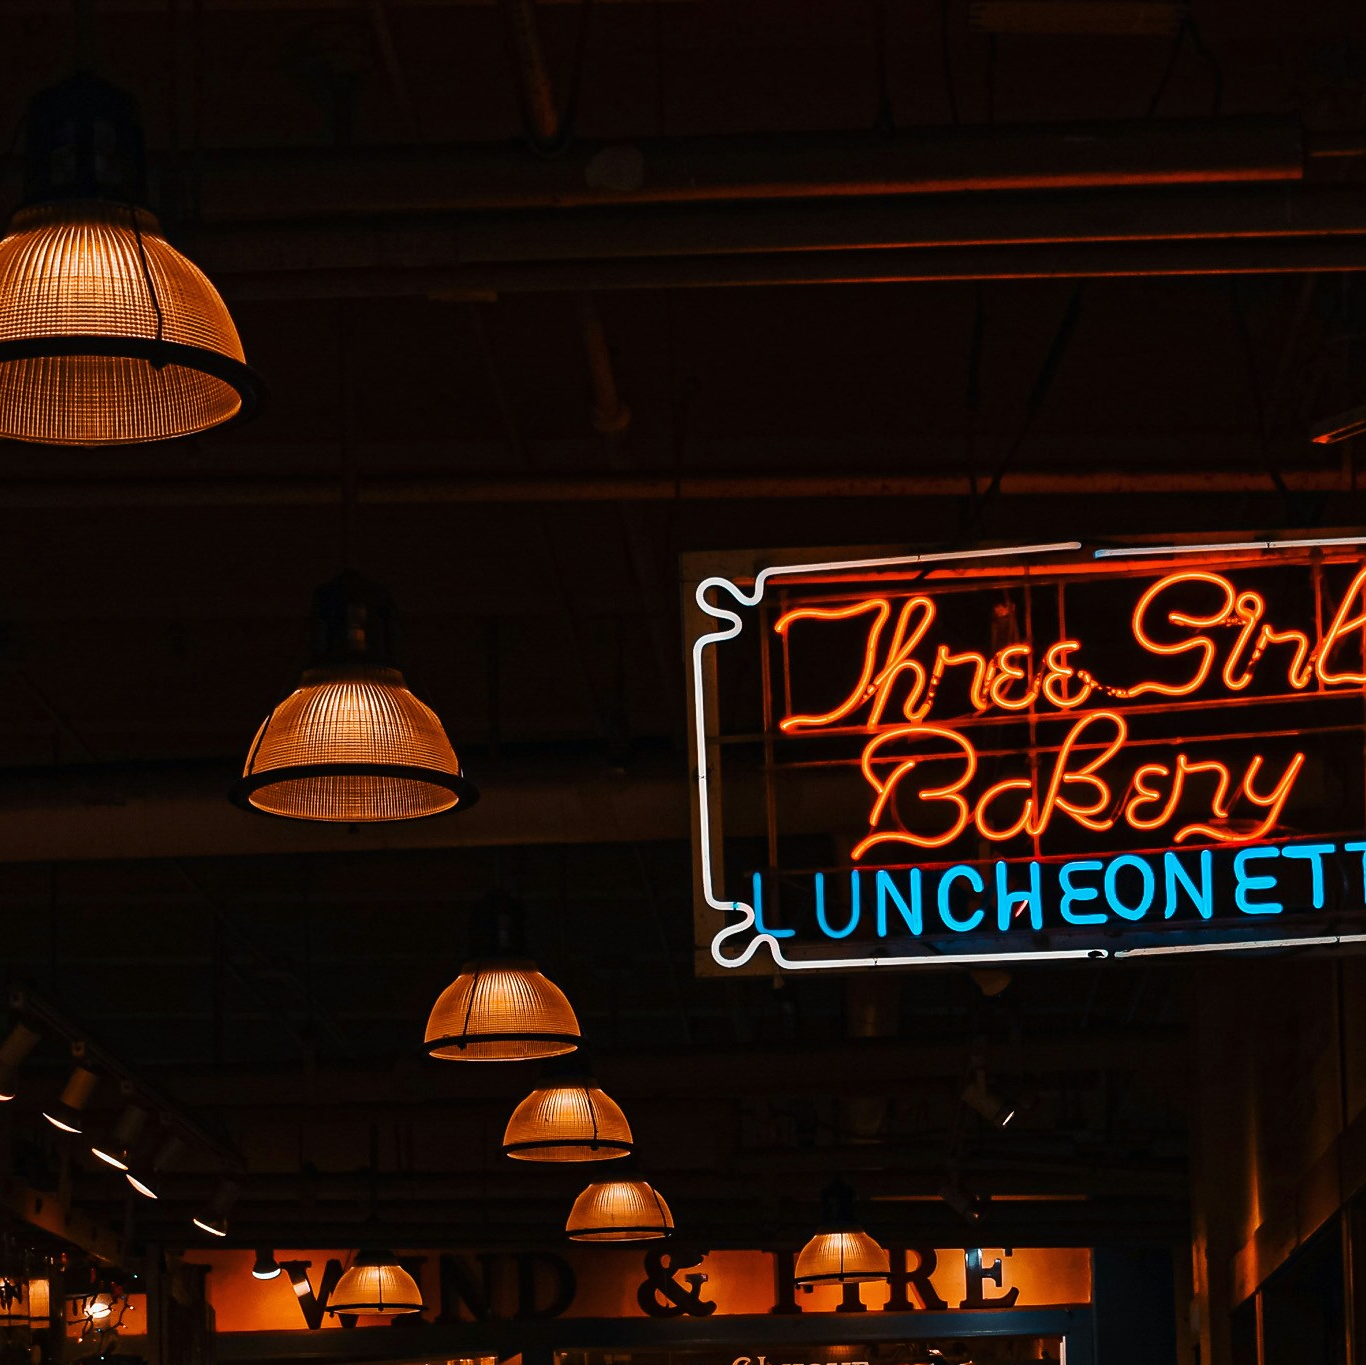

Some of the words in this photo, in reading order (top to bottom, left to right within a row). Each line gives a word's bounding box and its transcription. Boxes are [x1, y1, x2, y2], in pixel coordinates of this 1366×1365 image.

[775, 596, 1097, 733] Three
[851, 710, 1306, 860] Bakery
[638, 1247, 717, 1318] &
